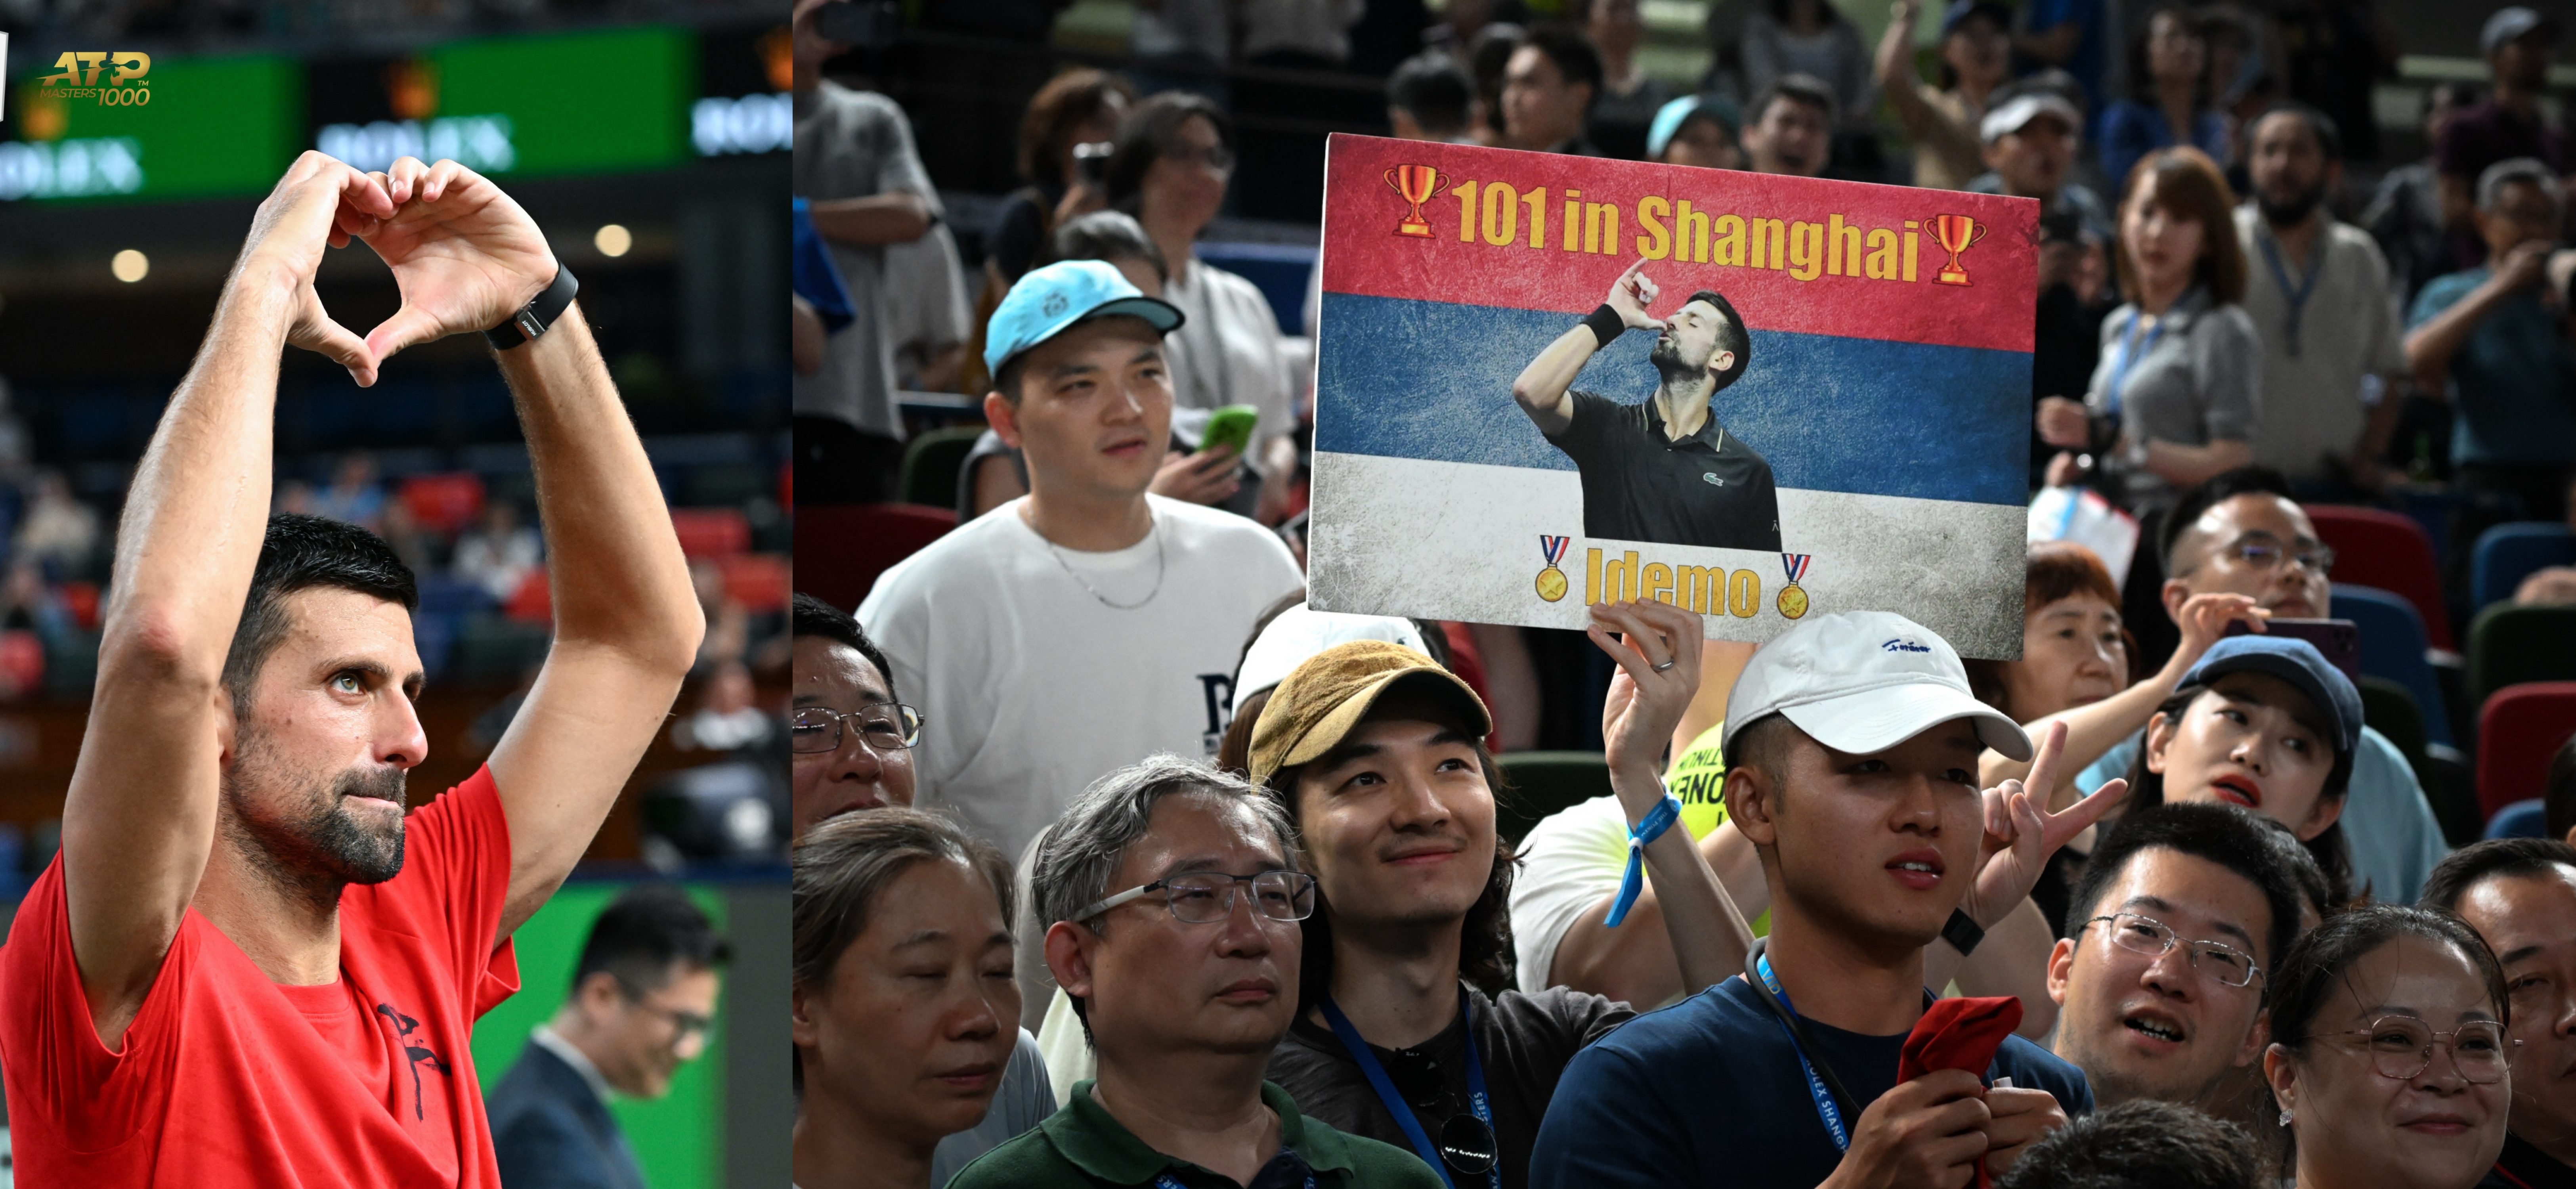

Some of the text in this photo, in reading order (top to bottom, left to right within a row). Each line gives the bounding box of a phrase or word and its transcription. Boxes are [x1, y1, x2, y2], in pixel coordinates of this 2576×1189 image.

[1451, 179, 1920, 283] 101 in Shanghai
[522, 320, 537, 336] HUBLOT
[1585, 548, 1760, 618] Idemo
